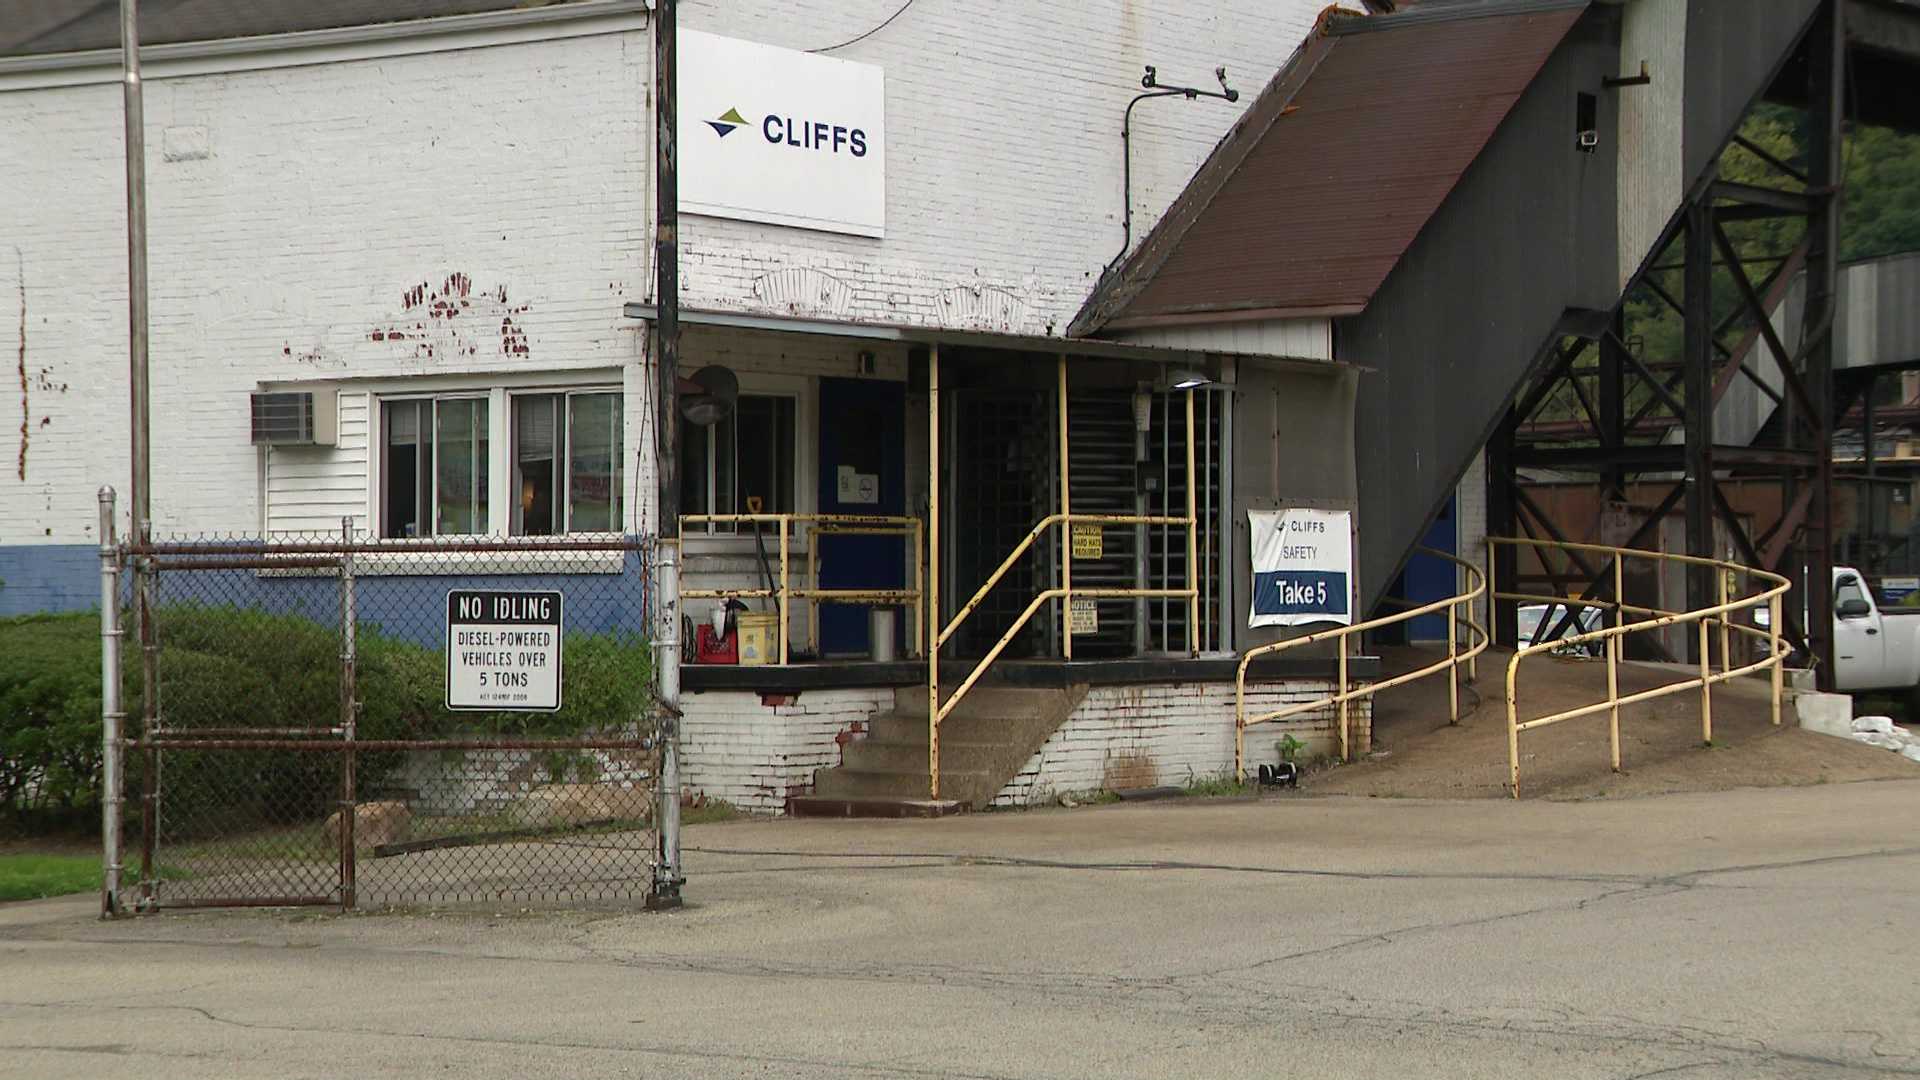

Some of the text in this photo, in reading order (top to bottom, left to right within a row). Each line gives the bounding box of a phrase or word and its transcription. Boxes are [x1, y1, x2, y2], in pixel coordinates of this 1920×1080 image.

[763, 114, 867, 158] CLIFFS
[1291, 520, 1325, 533] CLIFFS
[1283, 546, 1317, 560] SAFETY
[1275, 580, 1327, 606] Take 5
[459, 597, 550, 619] NO IDLING
[458, 632, 550, 647] DIESEL-POWERED
[462, 652, 546, 667] VEHICLES OVER
[480, 672, 528, 687] 5 TONS
